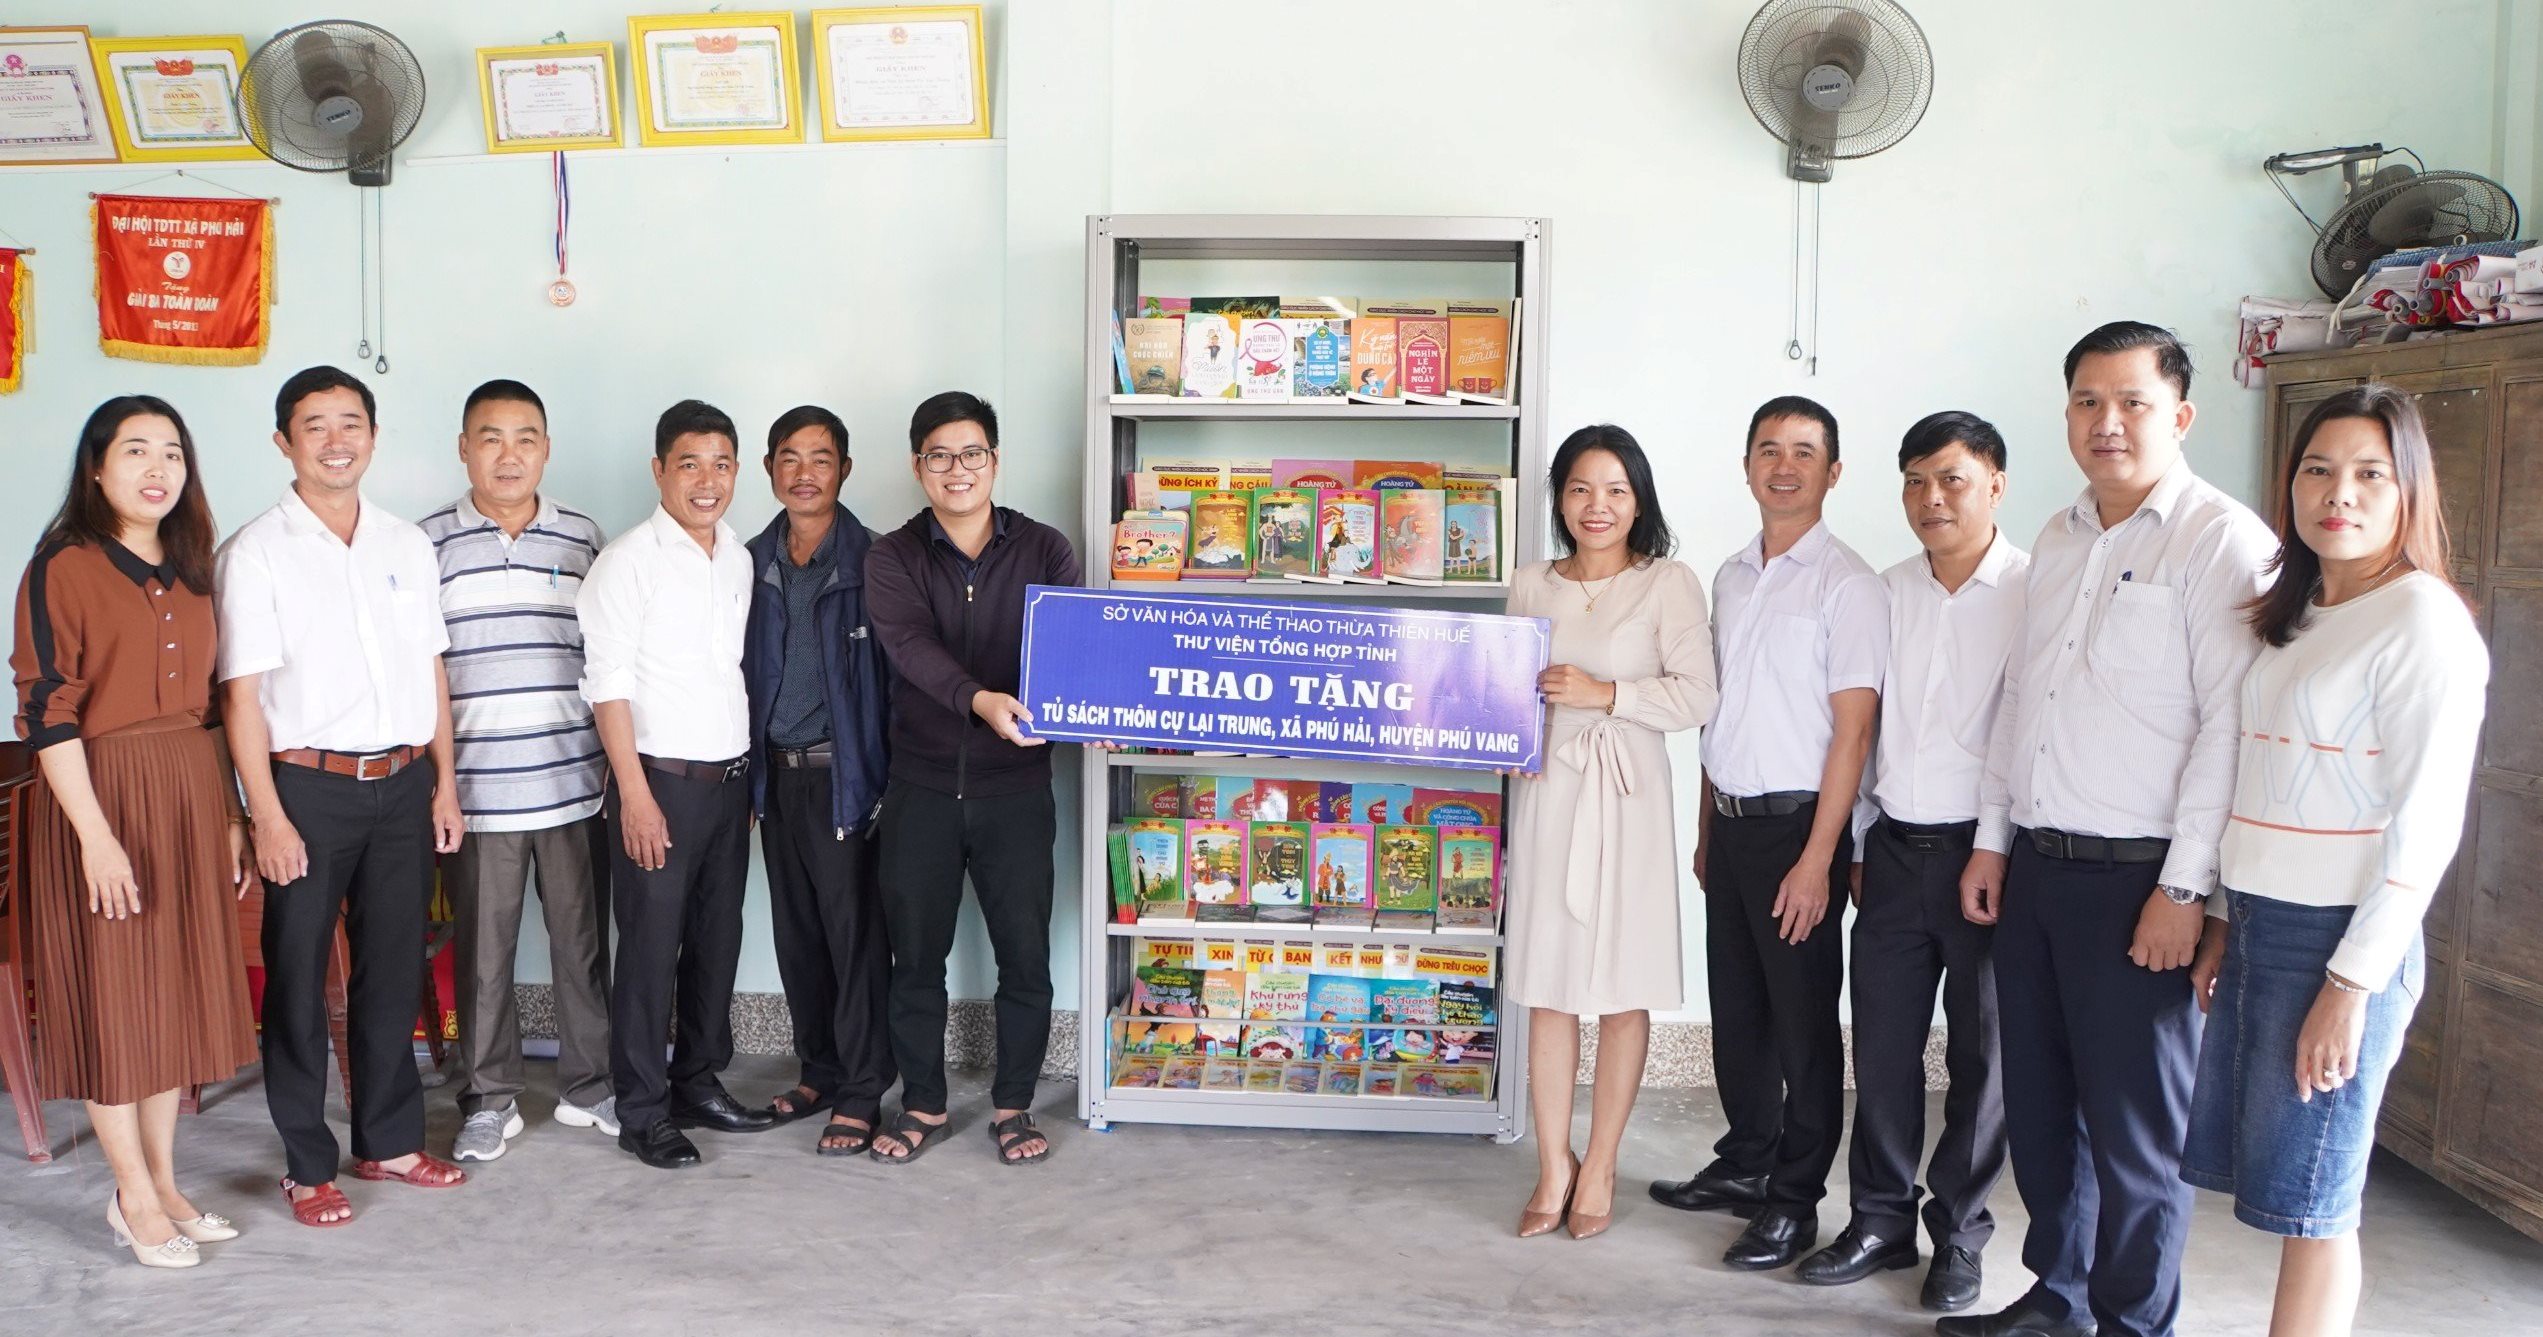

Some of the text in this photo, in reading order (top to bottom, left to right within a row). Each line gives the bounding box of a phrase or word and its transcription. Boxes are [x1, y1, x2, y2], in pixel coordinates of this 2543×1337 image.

[112, 216, 130, 234] ĐẠI
[132, 215, 152, 235] HỘI
[201, 219, 222, 235] PHÚ
[225, 218, 244, 236] HẢI
[148, 234, 168, 247] LẦN
[194, 239, 207, 249] IV
[127, 288, 148, 307] GIẢI
[163, 291, 193, 311] TOÀN
[1408, 349, 1438, 358] NGHÌN
[1412, 366, 1434, 375] MỘT
[1411, 375, 1436, 383] NGÀY
[1159, 476, 1183, 488] ỪNG
[1185, 476, 1202, 487] ÍCH
[1297, 480, 1324, 488] HOÀNG
[1103, 603, 1130, 622] SỞ
[1132, 605, 1167, 625] VĂN
[1171, 608, 1209, 627] HÓA
[1212, 611, 1235, 628] VÀ
[1238, 610, 1272, 631] THỂ
[1275, 616, 1323, 633] THAO
[1326, 618, 1376, 637] THỪA
[1434, 624, 1471, 643] HUẾ
[1173, 634, 1397, 663] THƯ VIỆN TỔNG HỢP TỈNH
[1149, 666, 1415, 711] TRAO TẶNG
[1042, 696, 1519, 754] TỦ SÁCH THÔN CỰ LẠI TRUNG, XÃ PHÚ HẢI, HUYỆN PHÚ VANG
[1154, 944, 1173, 957] TỰ
[1212, 950, 1234, 960] XIN
[1249, 948, 1266, 963] TỪ
[1285, 952, 1312, 965] BẠN
[1330, 951, 1353, 965] KẾT
[1416, 958, 1440, 970] ĐỪNG
[1441, 961, 1461, 971] TRÊU
[1462, 963, 1488, 975] CHỌC
